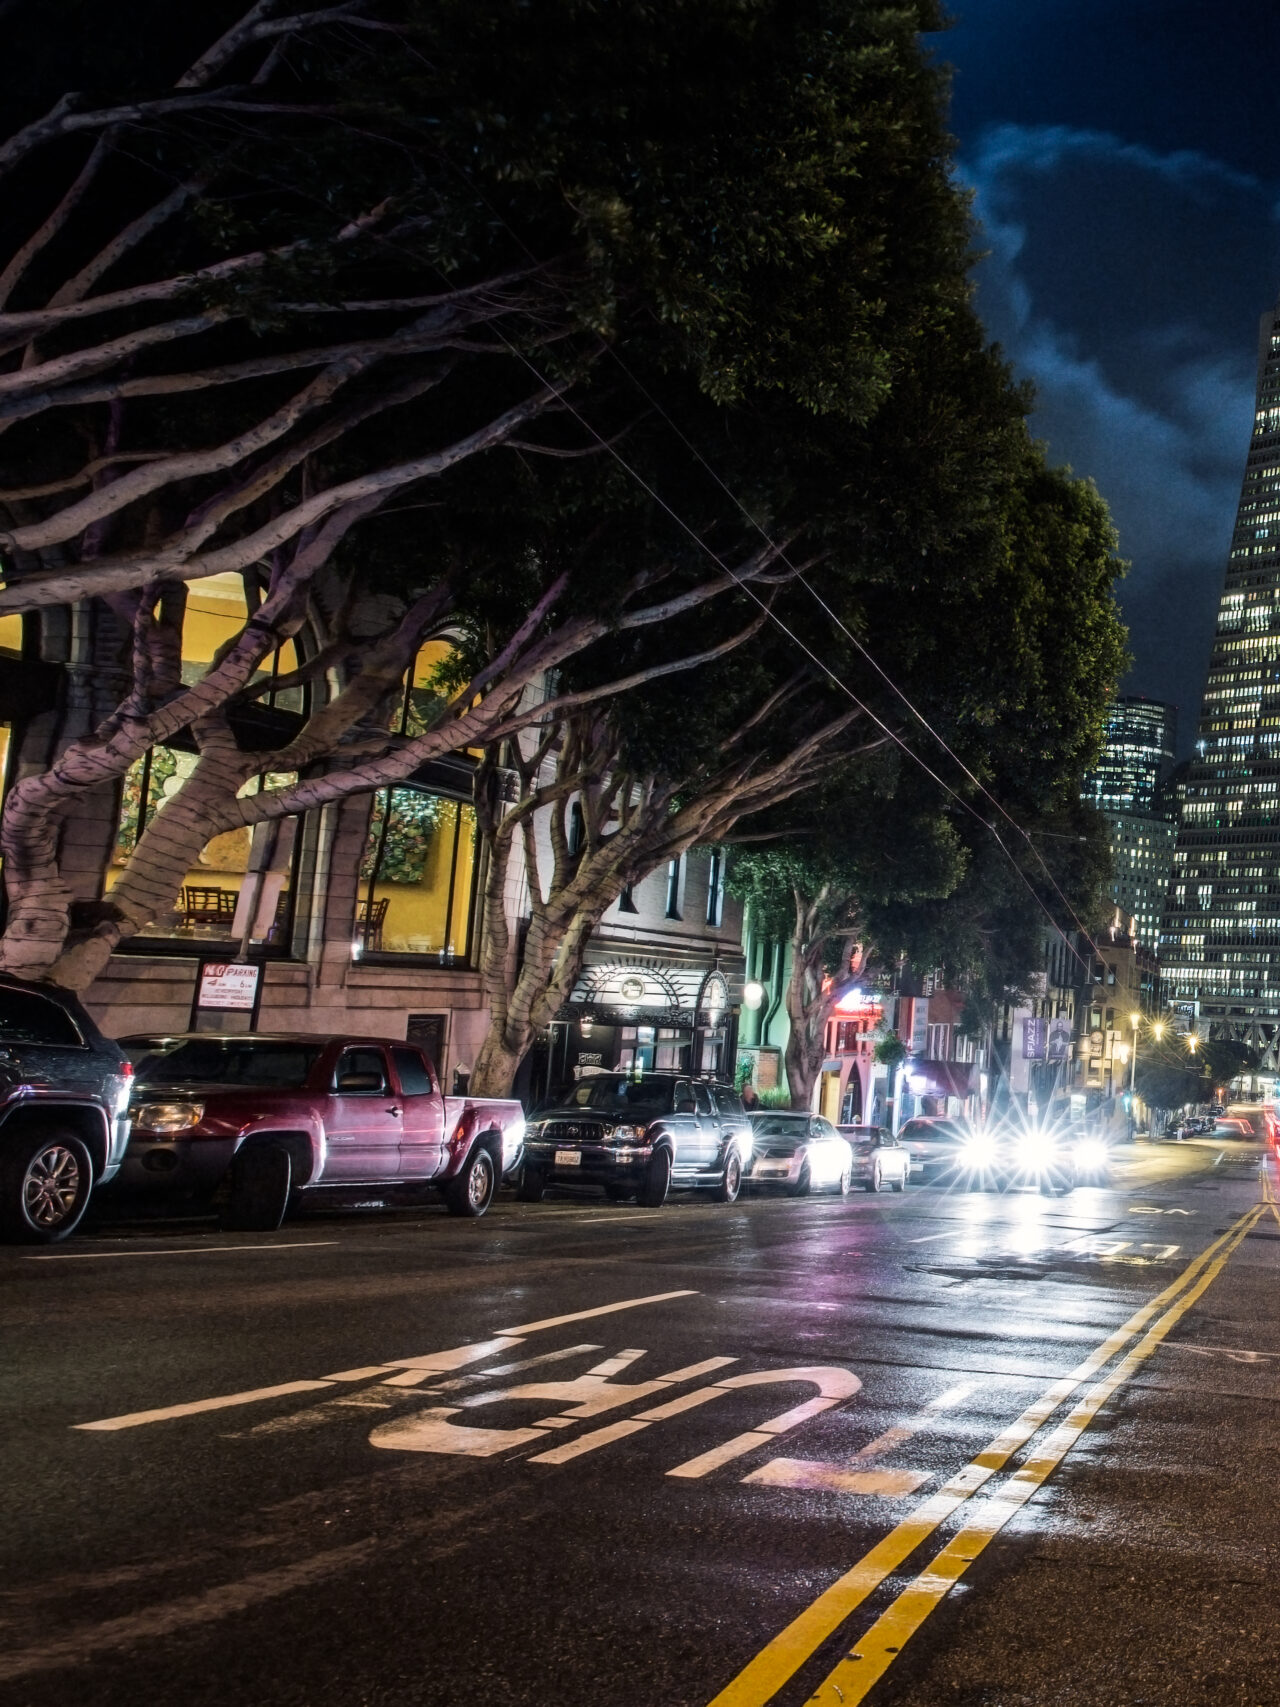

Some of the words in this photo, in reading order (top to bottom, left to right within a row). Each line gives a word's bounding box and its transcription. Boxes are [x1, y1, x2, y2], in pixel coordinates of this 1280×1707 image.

[203, 965, 227, 977] NO
[226, 968, 257, 977] PARKING
[1026, 1019, 1036, 1058] SFJAZZ
[578, 1053, 602, 1065] BAR
